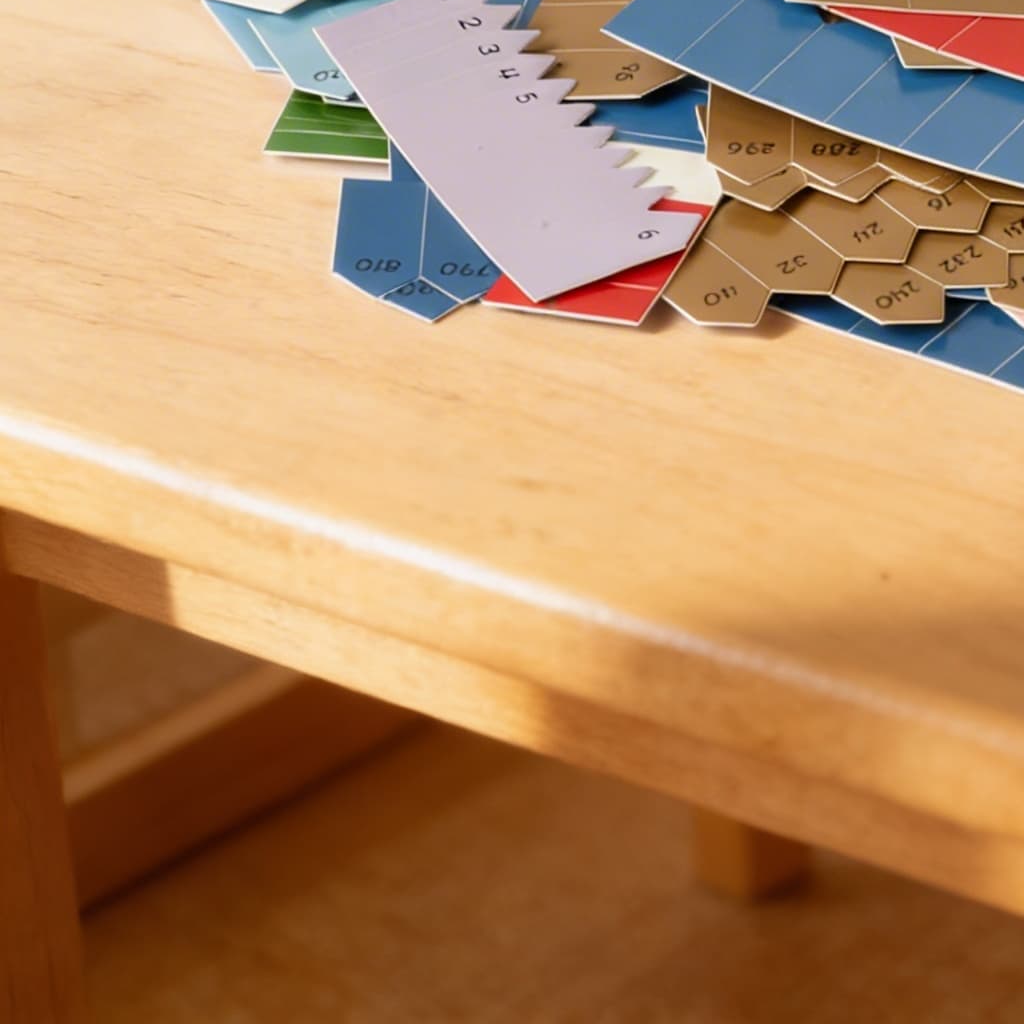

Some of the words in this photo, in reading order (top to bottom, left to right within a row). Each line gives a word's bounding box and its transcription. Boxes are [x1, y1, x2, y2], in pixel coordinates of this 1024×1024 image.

[459, 16, 482, 32] 2
[478, 42, 500, 57] 3
[516, 90, 538, 103] 5
[727, 141, 776, 156] 296
[355, 258, 400, 274] 810
